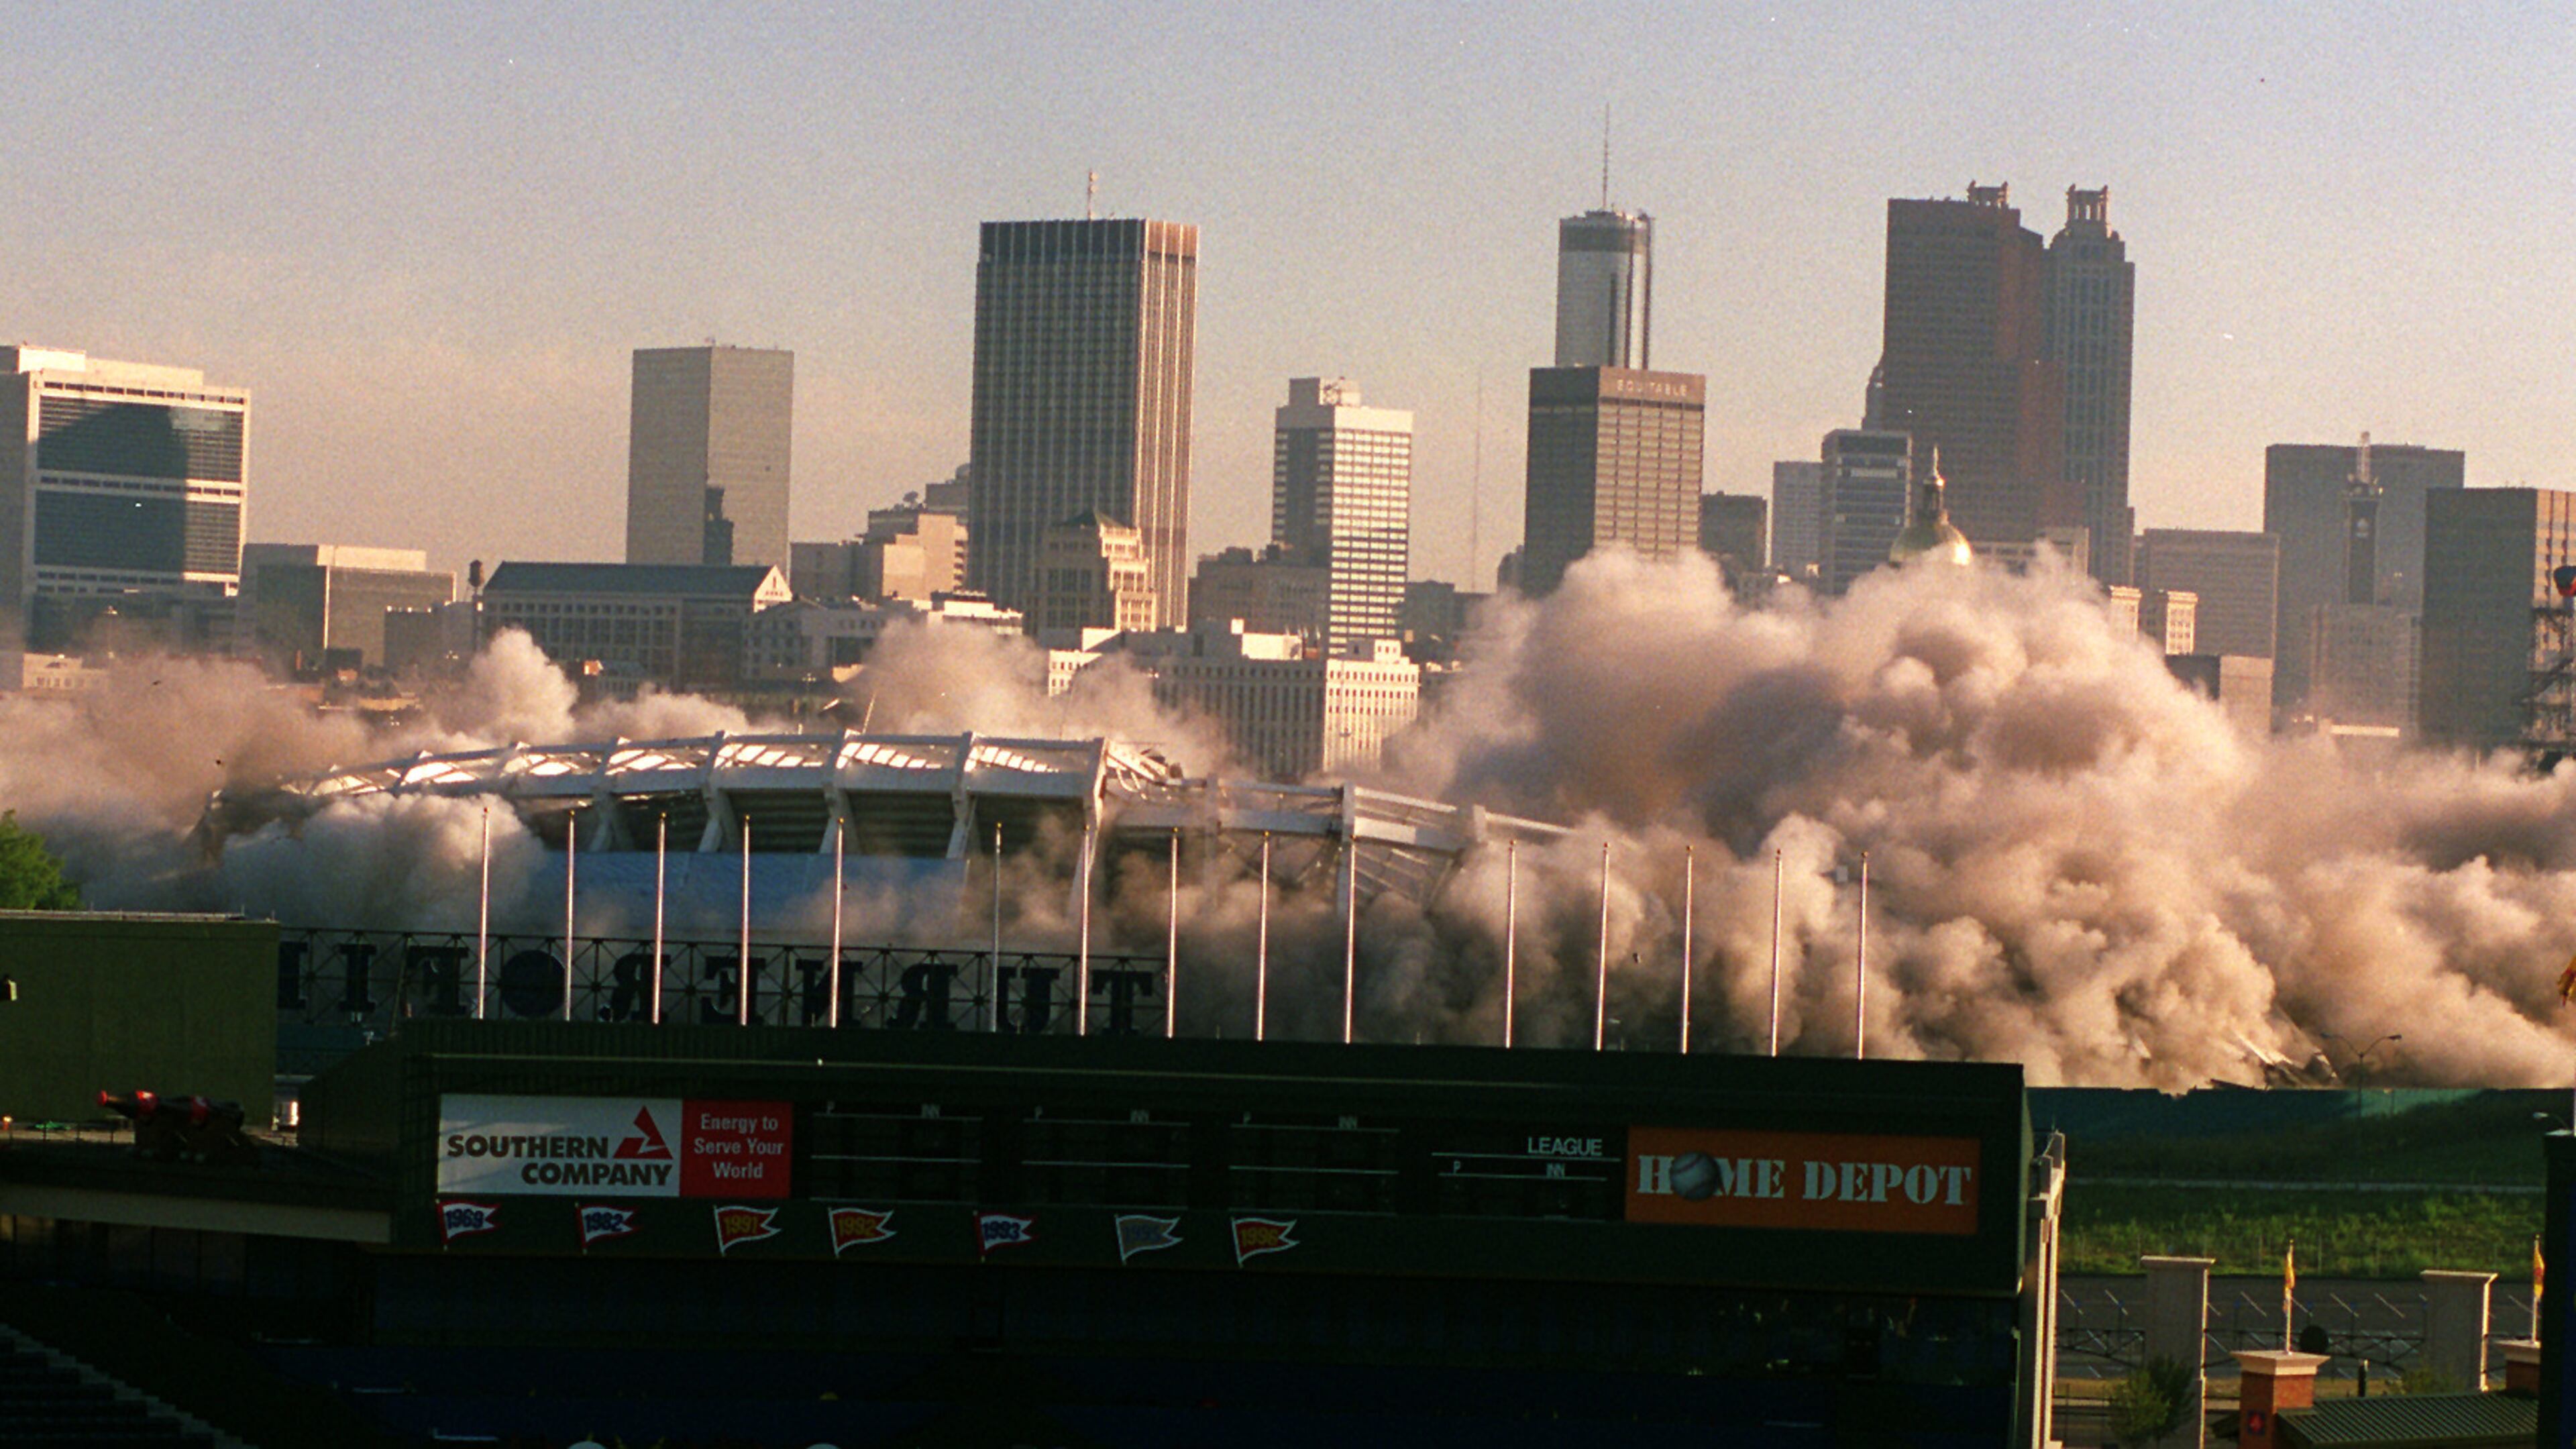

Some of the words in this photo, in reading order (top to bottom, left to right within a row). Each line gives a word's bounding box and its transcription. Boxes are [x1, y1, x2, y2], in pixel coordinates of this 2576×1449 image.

[1617, 379, 1687, 396] EQUTABLE
[701, 1113, 755, 1134] Energy
[761, 1115, 780, 1132] to
[447, 1135, 608, 1159] SOUTHERN
[694, 1138, 743, 1155] Serve
[746, 1139, 784, 1155] Your
[1527, 1136, 1603, 1157] LEAGUE
[522, 1163, 672, 1185] COMPANY
[713, 1161, 763, 1179] World
[1802, 1160, 1971, 1205] DEPOT
[445, 1208, 482, 1228] 1969
[584, 1212, 623, 1232] 1982
[722, 1216, 757, 1235] 1991
[838, 1216, 877, 1237] 1992
[983, 1221, 1020, 1240] 1993
